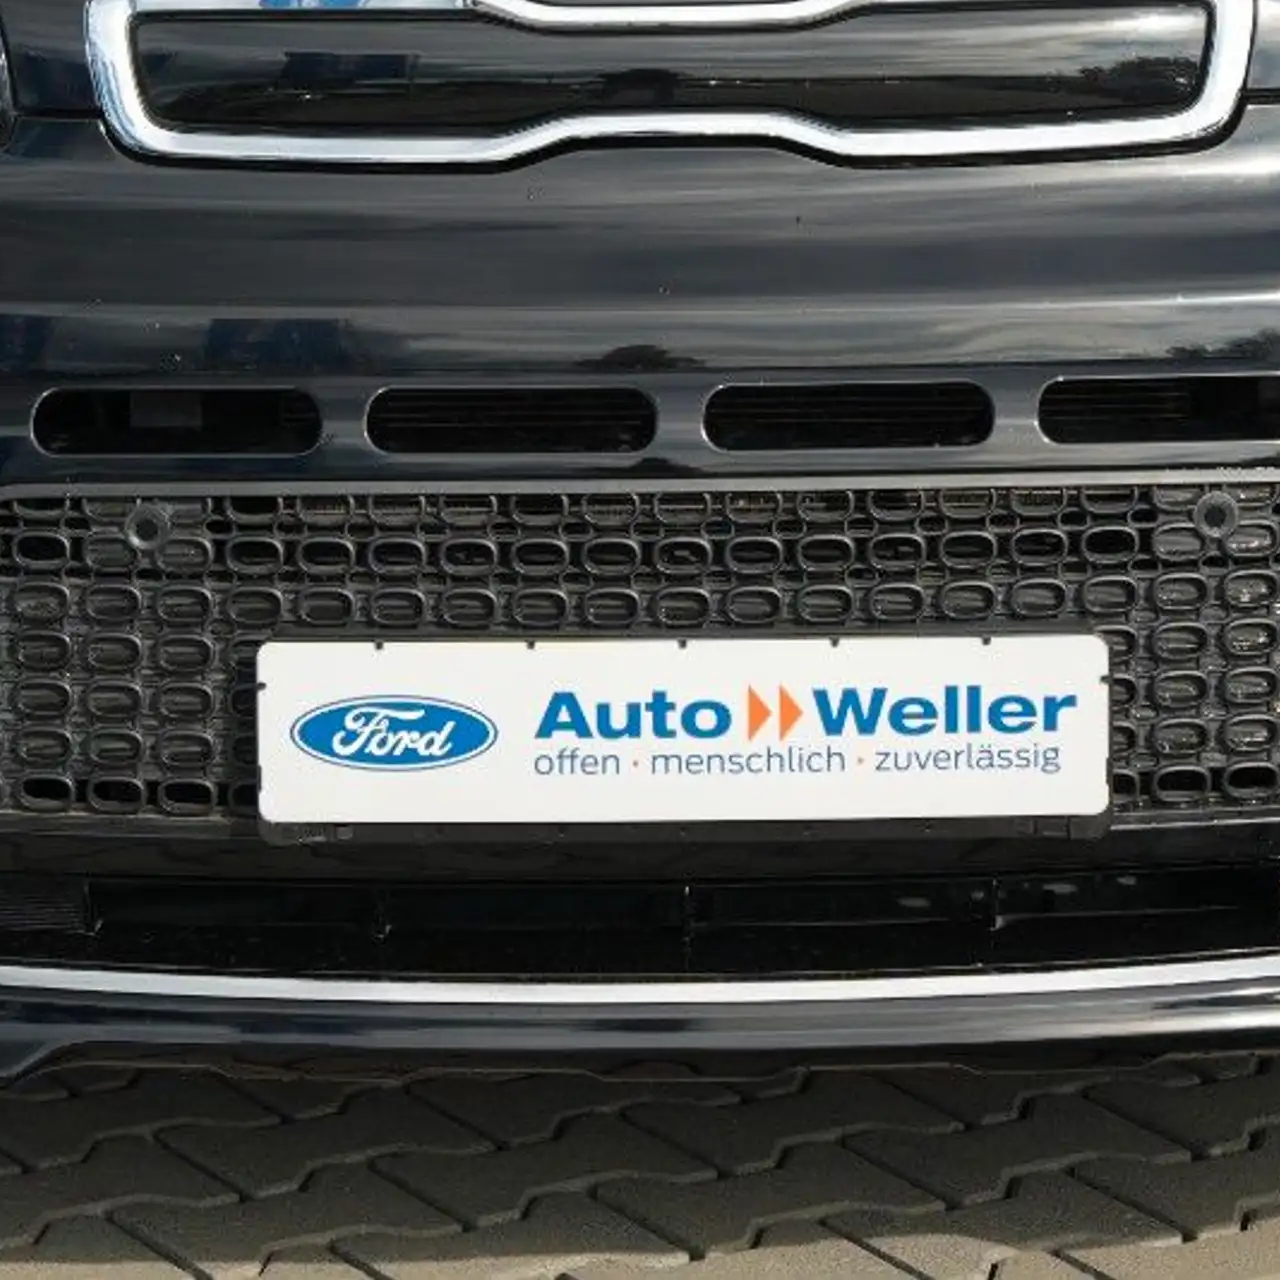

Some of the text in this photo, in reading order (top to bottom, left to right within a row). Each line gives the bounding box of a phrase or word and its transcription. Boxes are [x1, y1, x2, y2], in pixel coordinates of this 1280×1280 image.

[332, 706, 457, 757] Ford
[534, 684, 1079, 742] Auto Weller
[534, 743, 1062, 775] offen menschlich zuverlässig
